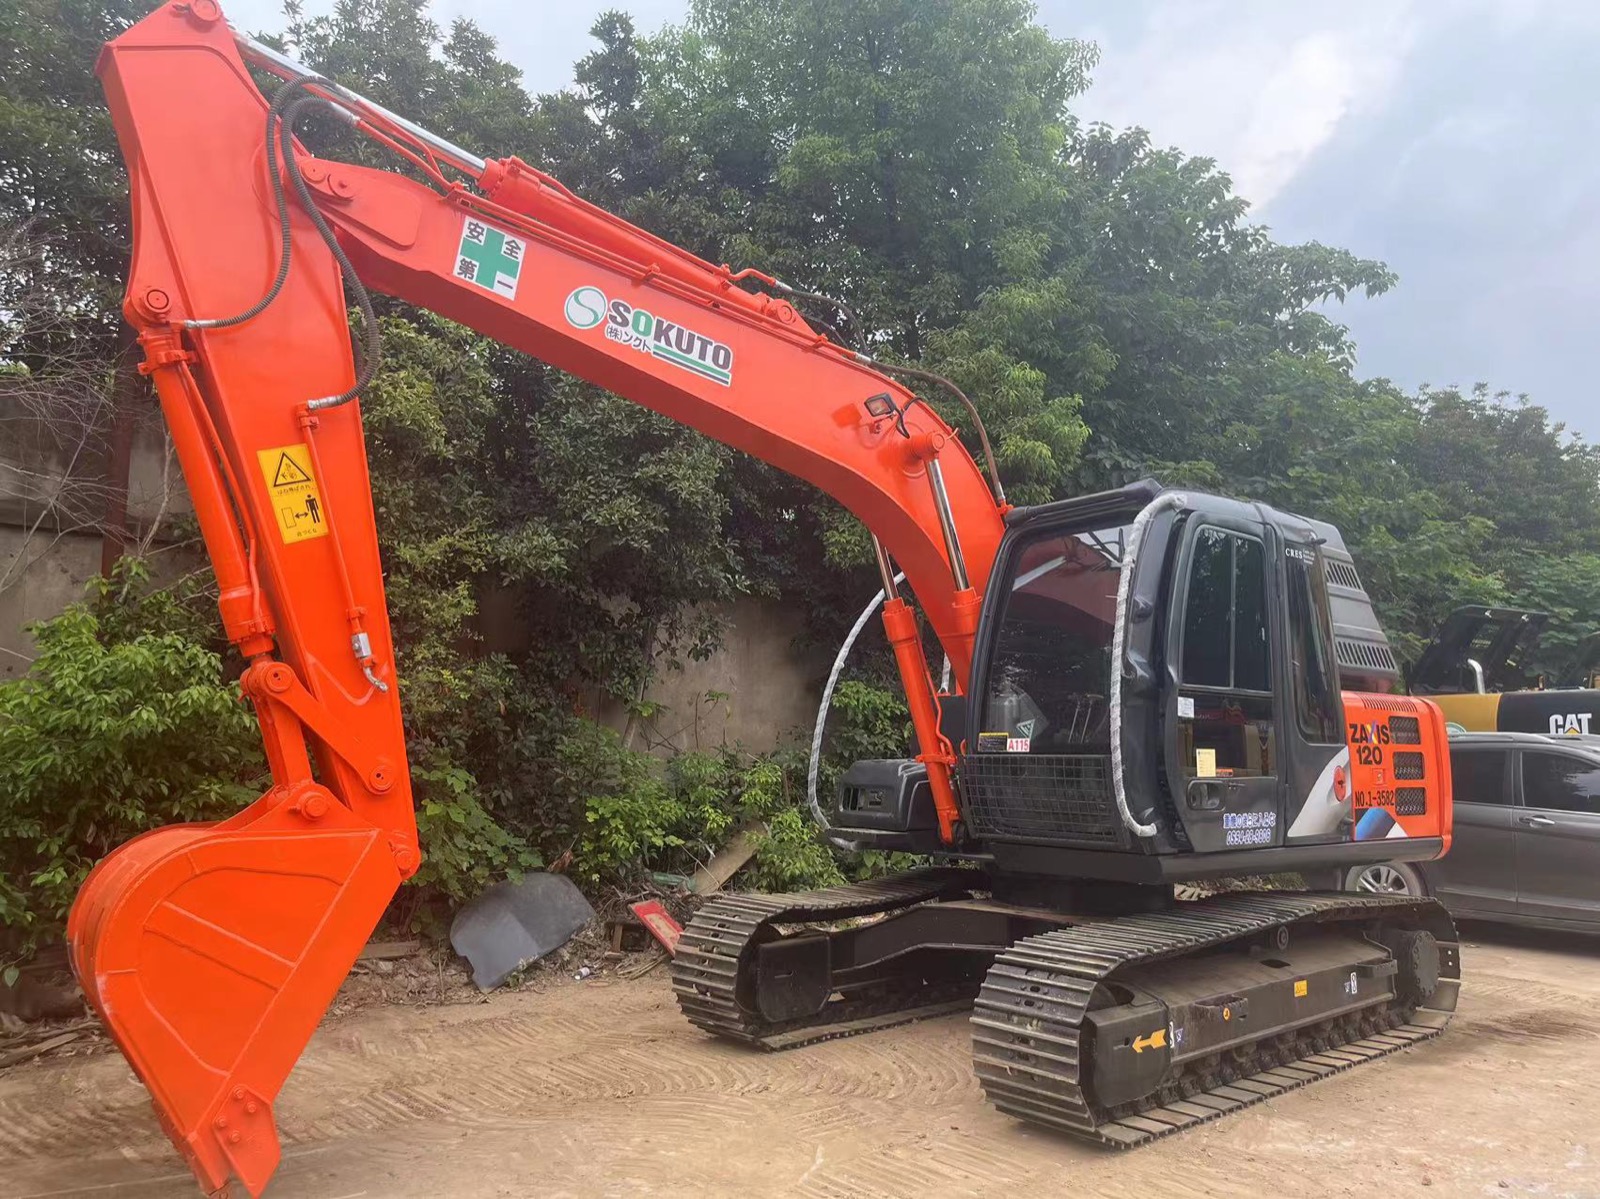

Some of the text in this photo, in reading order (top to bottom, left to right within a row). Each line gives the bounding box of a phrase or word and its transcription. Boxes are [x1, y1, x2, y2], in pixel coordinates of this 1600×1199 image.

[466, 221, 522, 260] 安全
[608, 301, 732, 371] SOKUTO
[1285, 547, 1303, 559] CRES
[1349, 719, 1390, 745] ZAXIS
[1549, 713, 1592, 735] CAT
[1008, 739, 1029, 751] A115
[1356, 745, 1383, 766] 120
